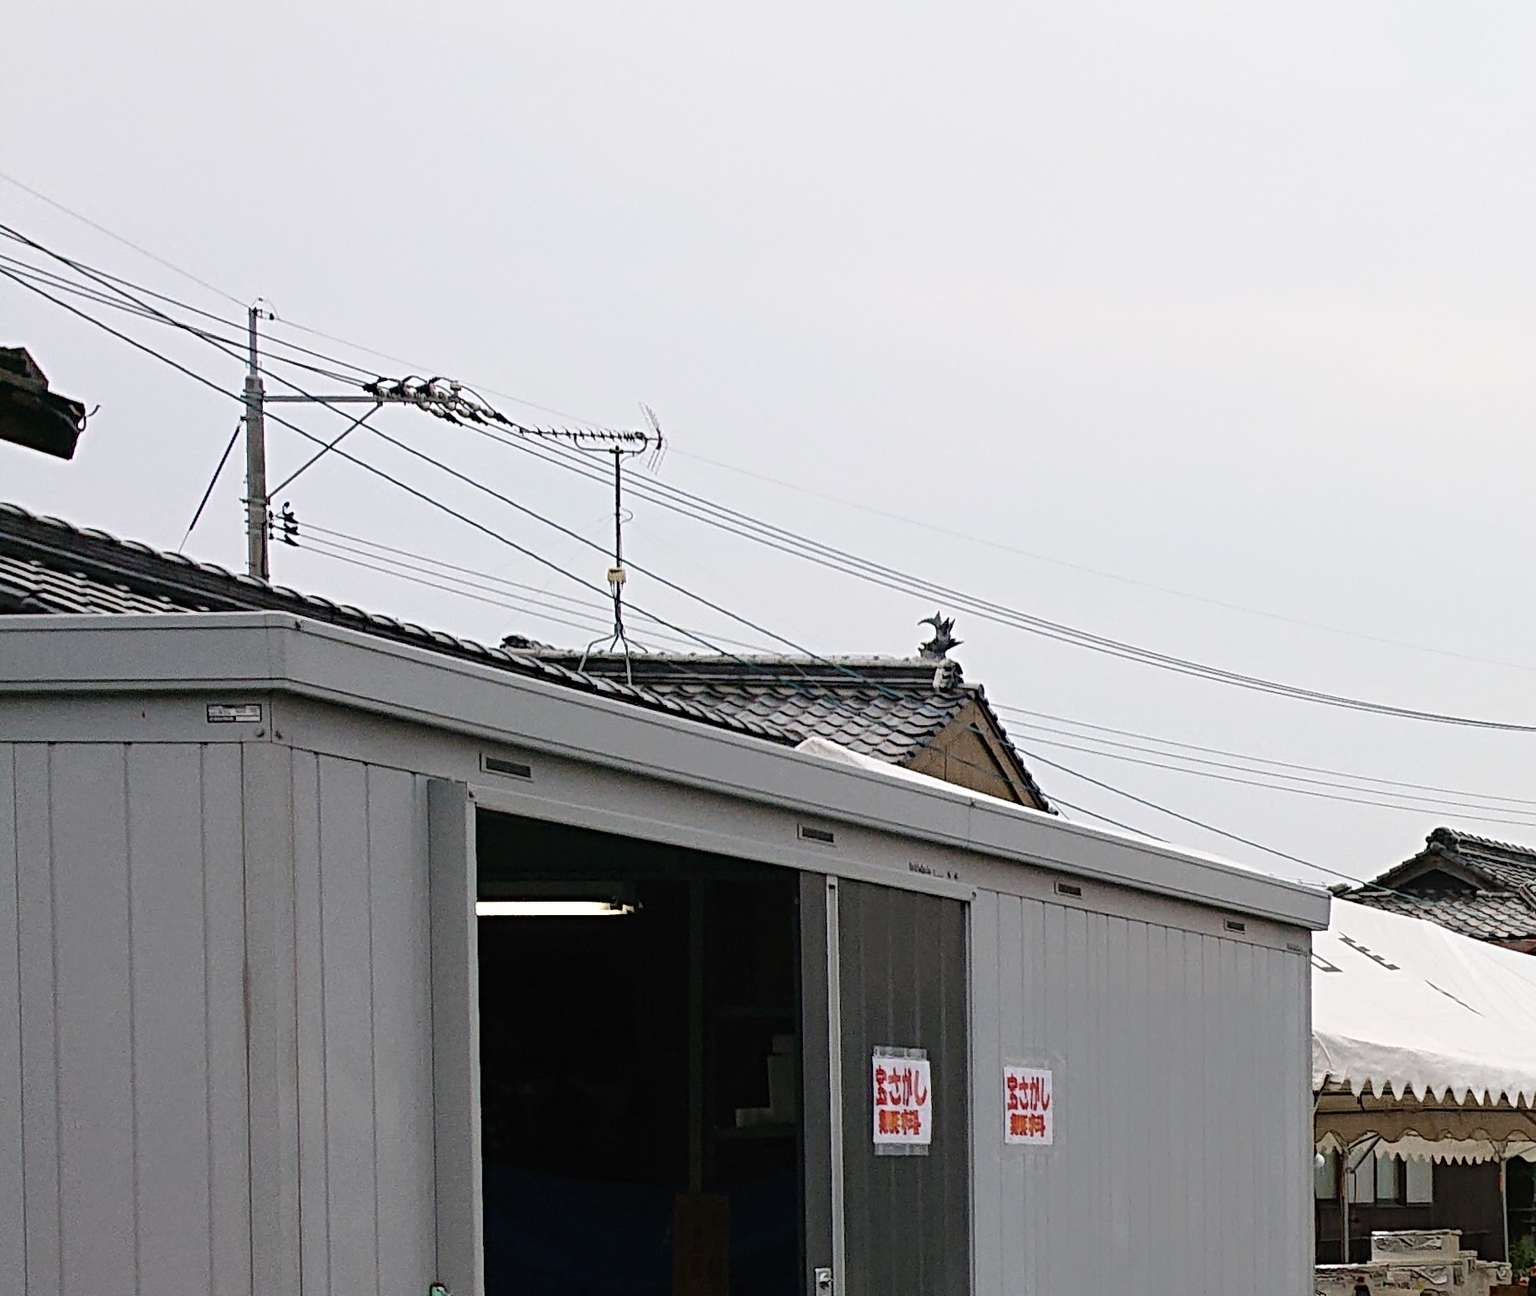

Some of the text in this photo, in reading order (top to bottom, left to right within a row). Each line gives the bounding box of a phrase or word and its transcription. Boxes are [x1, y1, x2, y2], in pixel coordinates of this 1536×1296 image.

[876, 1064, 928, 1106] 宝さがし
[1006, 1073, 1050, 1111] 宝さがし
